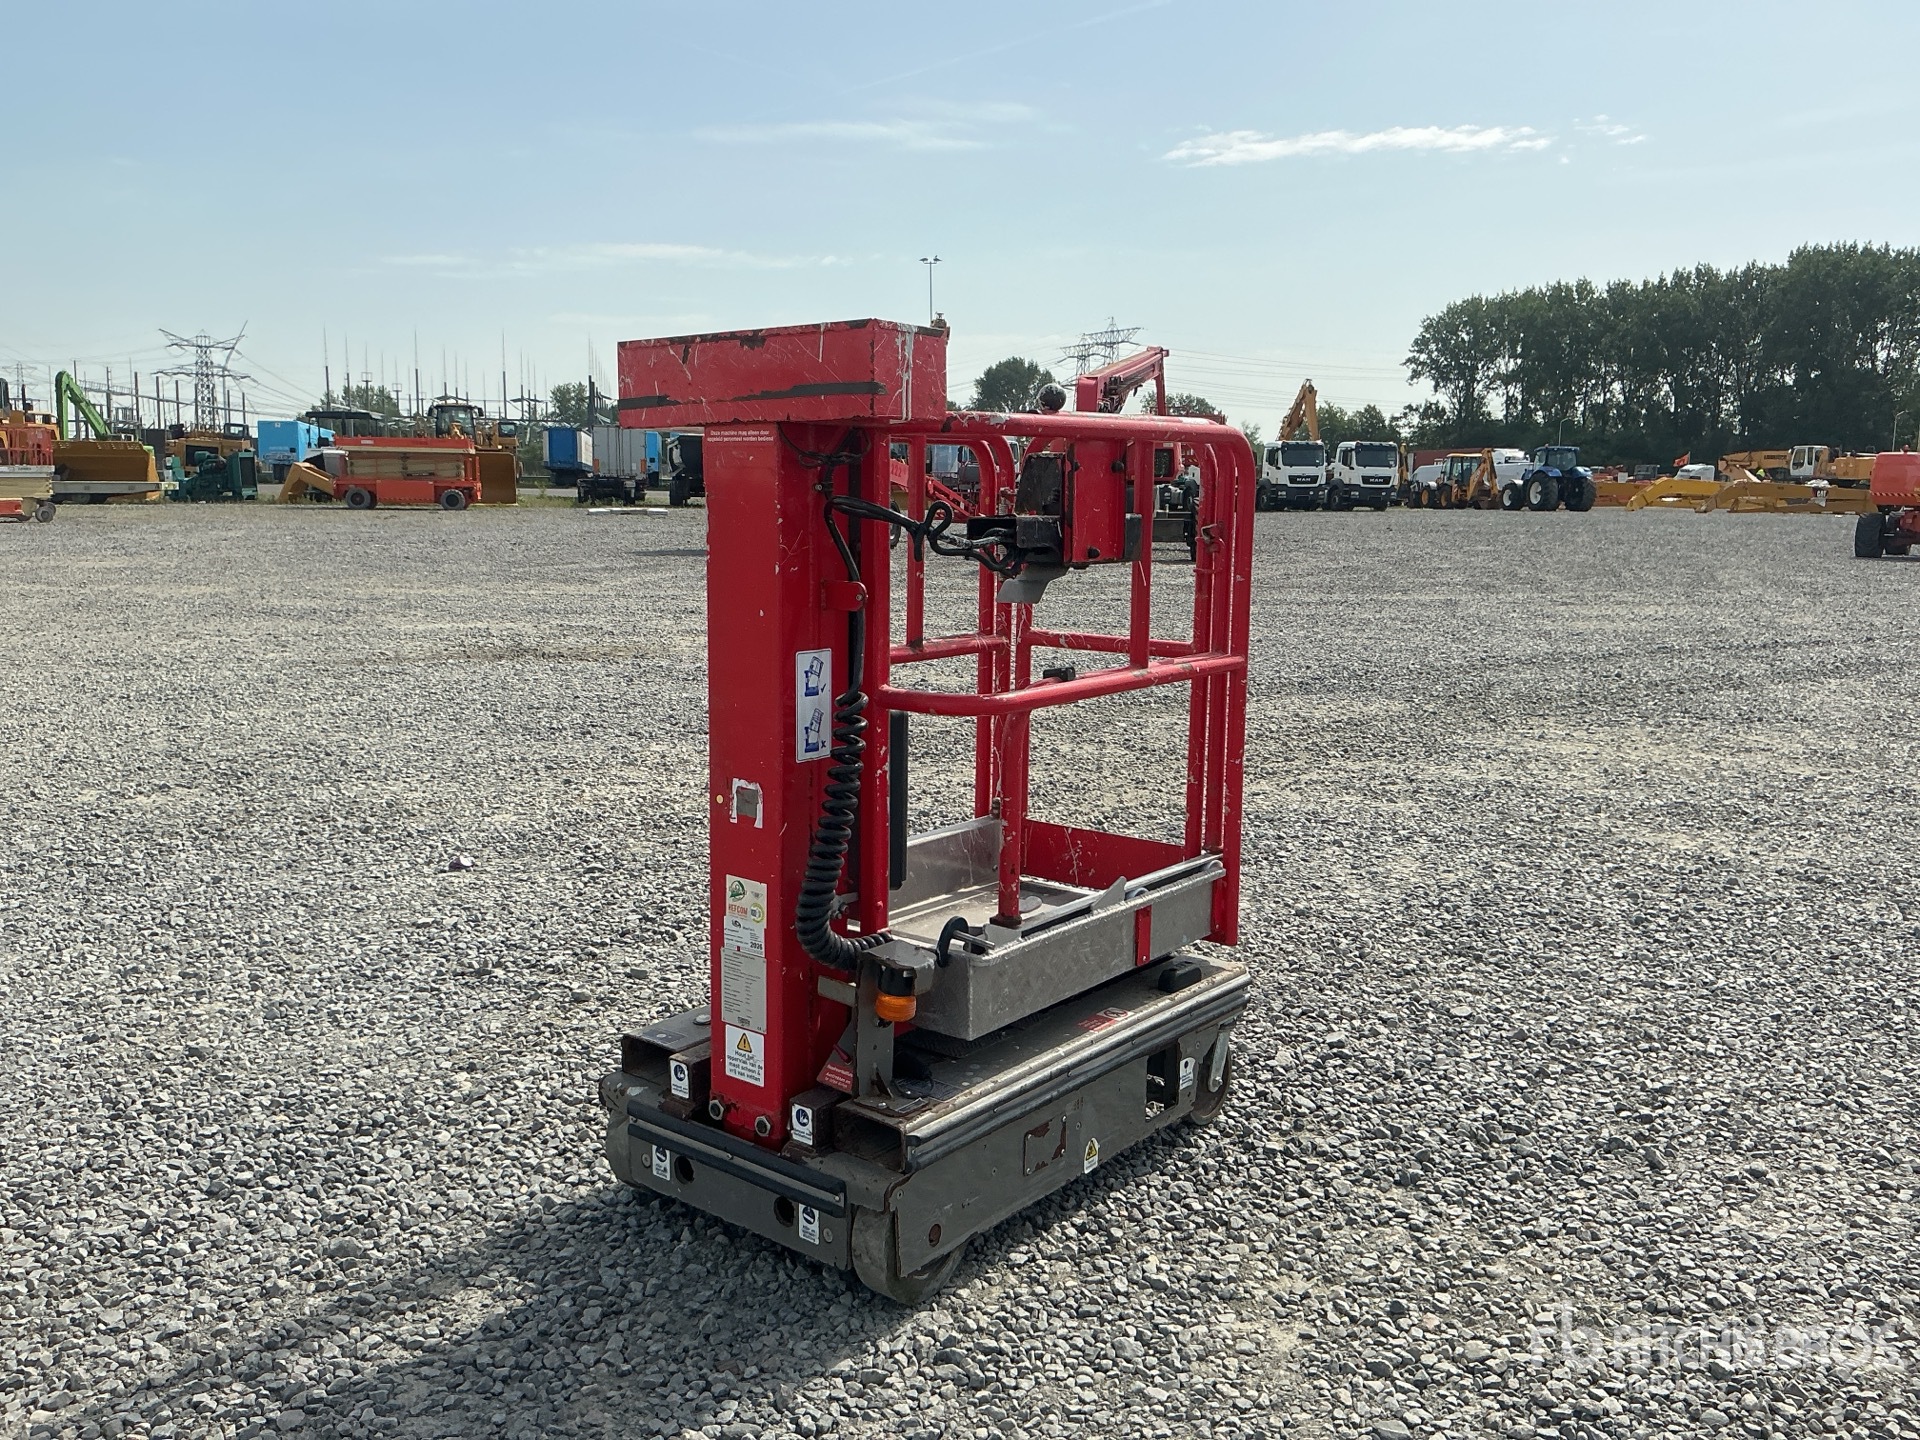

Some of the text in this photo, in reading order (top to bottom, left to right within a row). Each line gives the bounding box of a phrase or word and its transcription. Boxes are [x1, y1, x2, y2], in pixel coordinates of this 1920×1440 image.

[1816, 490, 1827, 498] CAT
[734, 1049, 746, 1059] Houd
[726, 1054, 748, 1065] oppervlak
[729, 1061, 740, 1069] mast
[741, 1065, 756, 1074] schoon
[729, 1067, 737, 1075] vrij
